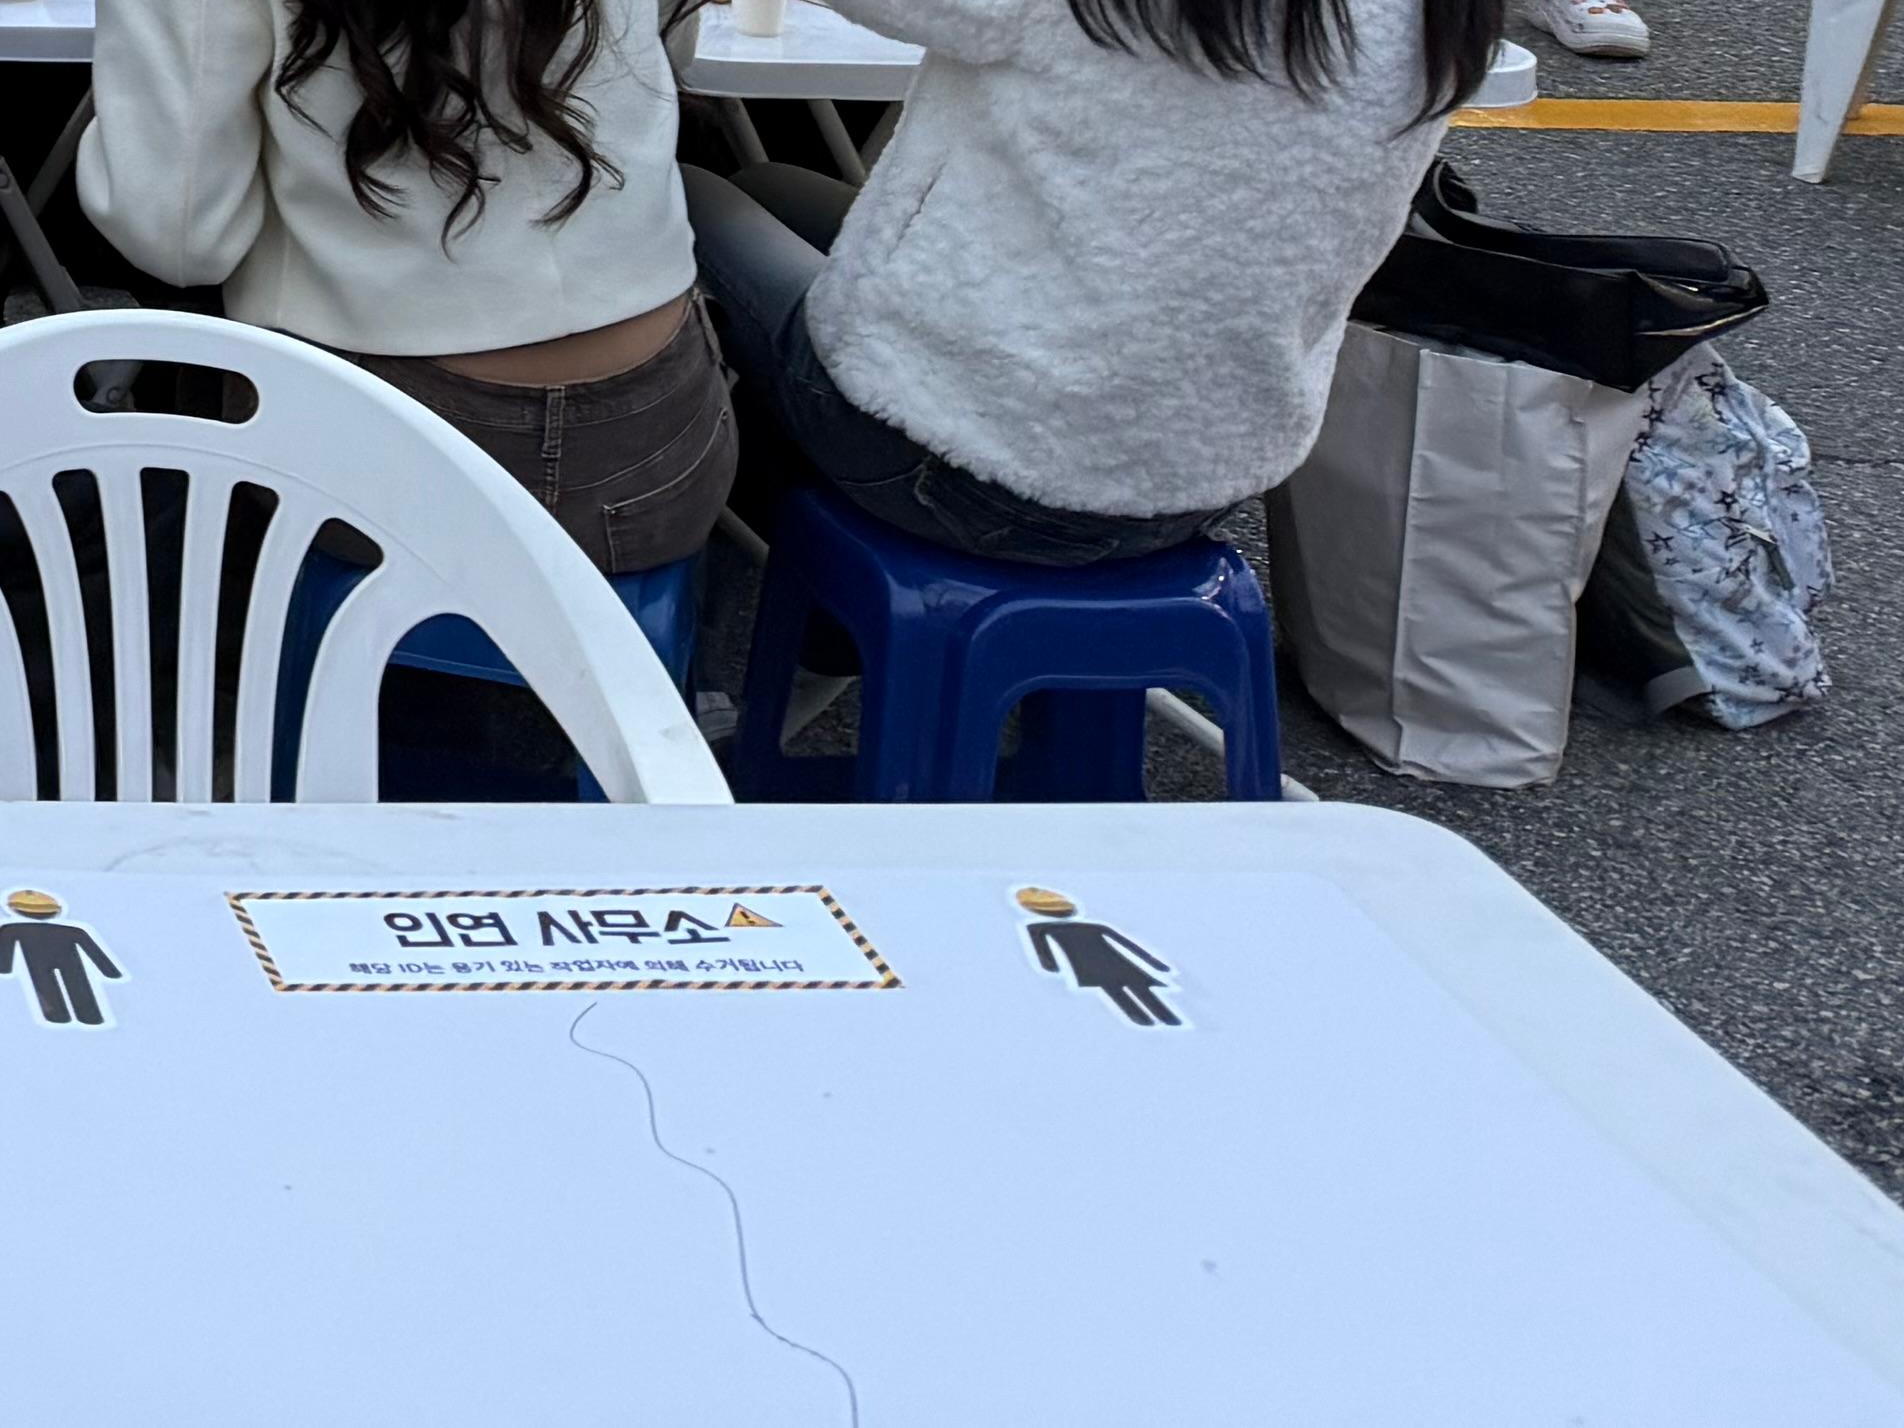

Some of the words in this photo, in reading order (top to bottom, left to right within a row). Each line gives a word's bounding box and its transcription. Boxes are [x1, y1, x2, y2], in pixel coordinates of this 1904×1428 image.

[383, 911, 519, 949] 인연
[537, 909, 730, 946] 사무소
[349, 961, 392, 975] 해당
[399, 962, 445, 975] ID는
[453, 960, 495, 974] 용기
[501, 960, 544, 974] 있는
[550, 959, 639, 973] 작업자에
[644, 959, 689, 973] 의해
[695, 958, 805, 973] 수거됩니다
